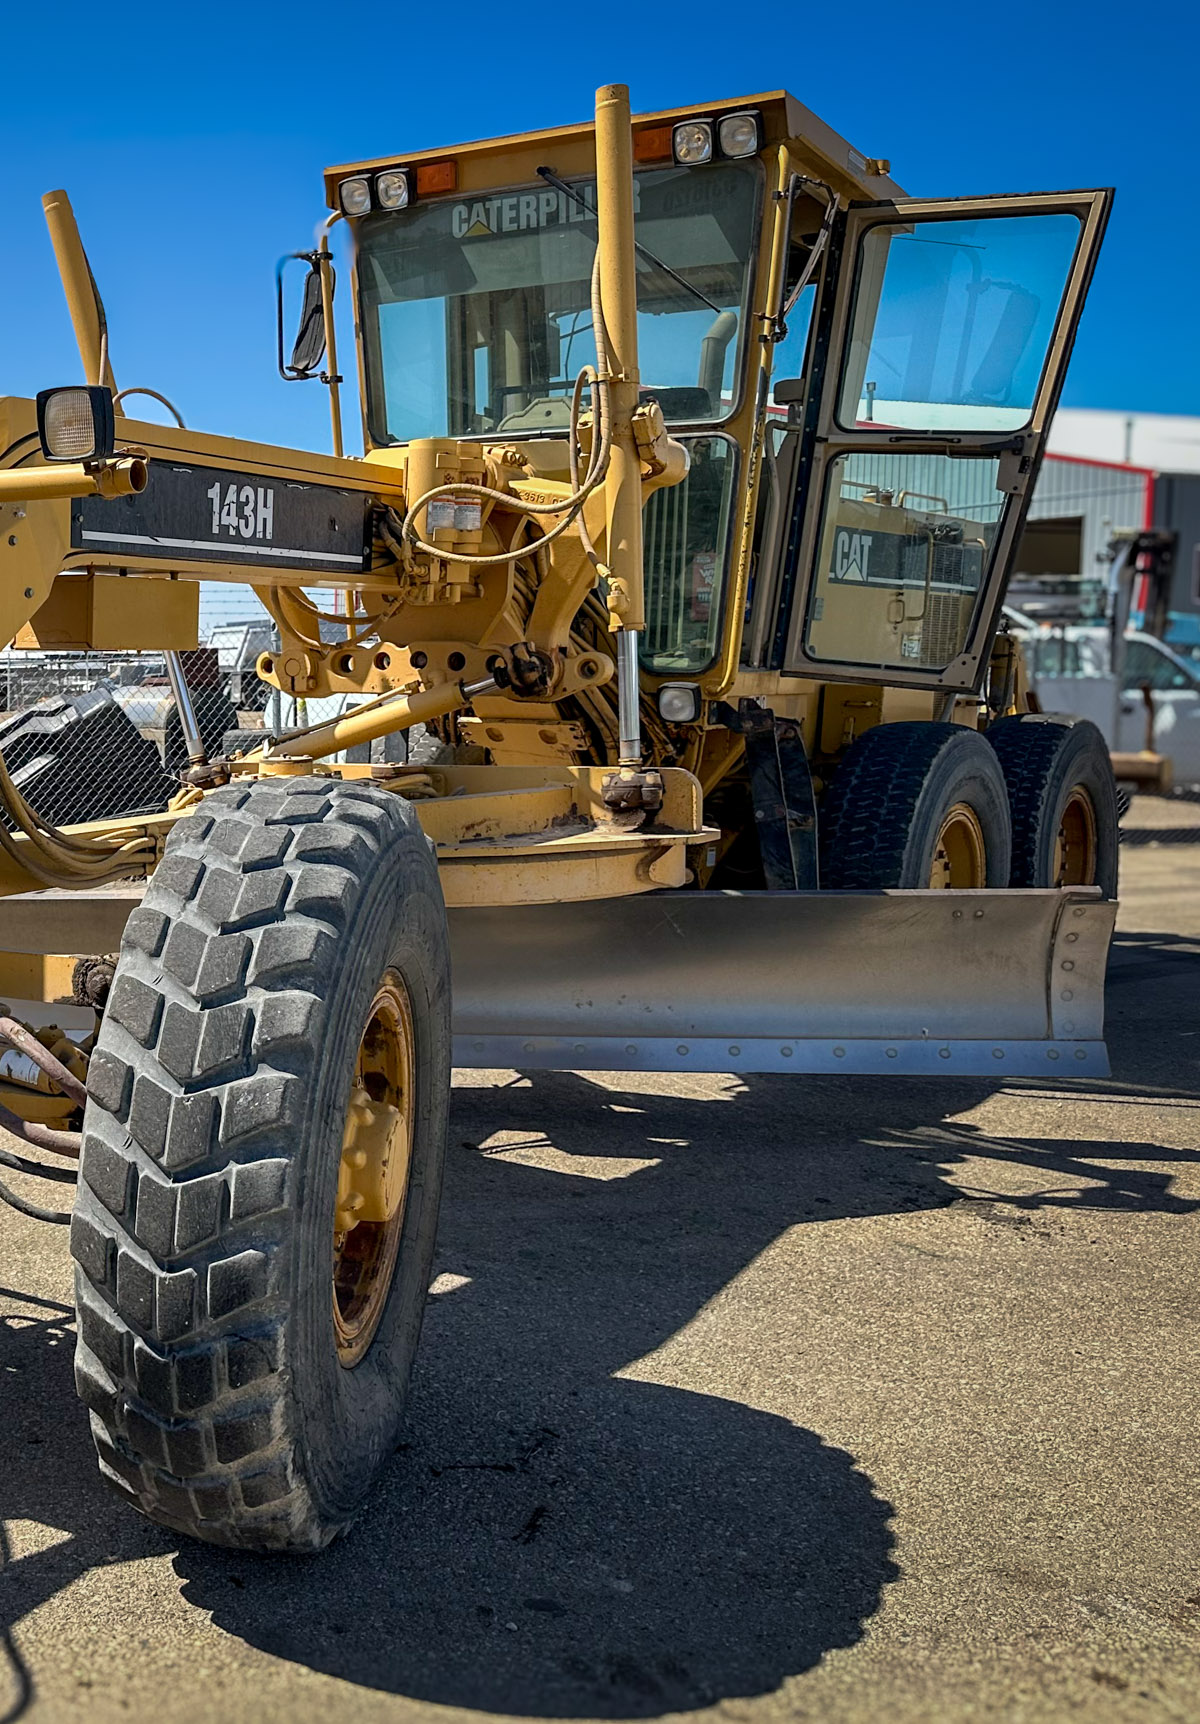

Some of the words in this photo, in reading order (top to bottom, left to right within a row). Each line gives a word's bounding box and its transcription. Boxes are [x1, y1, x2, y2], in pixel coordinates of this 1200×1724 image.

[452, 179, 641, 239] CATERPILL
[207, 482, 274, 540] 143H
[835, 531, 873, 583] CAT
